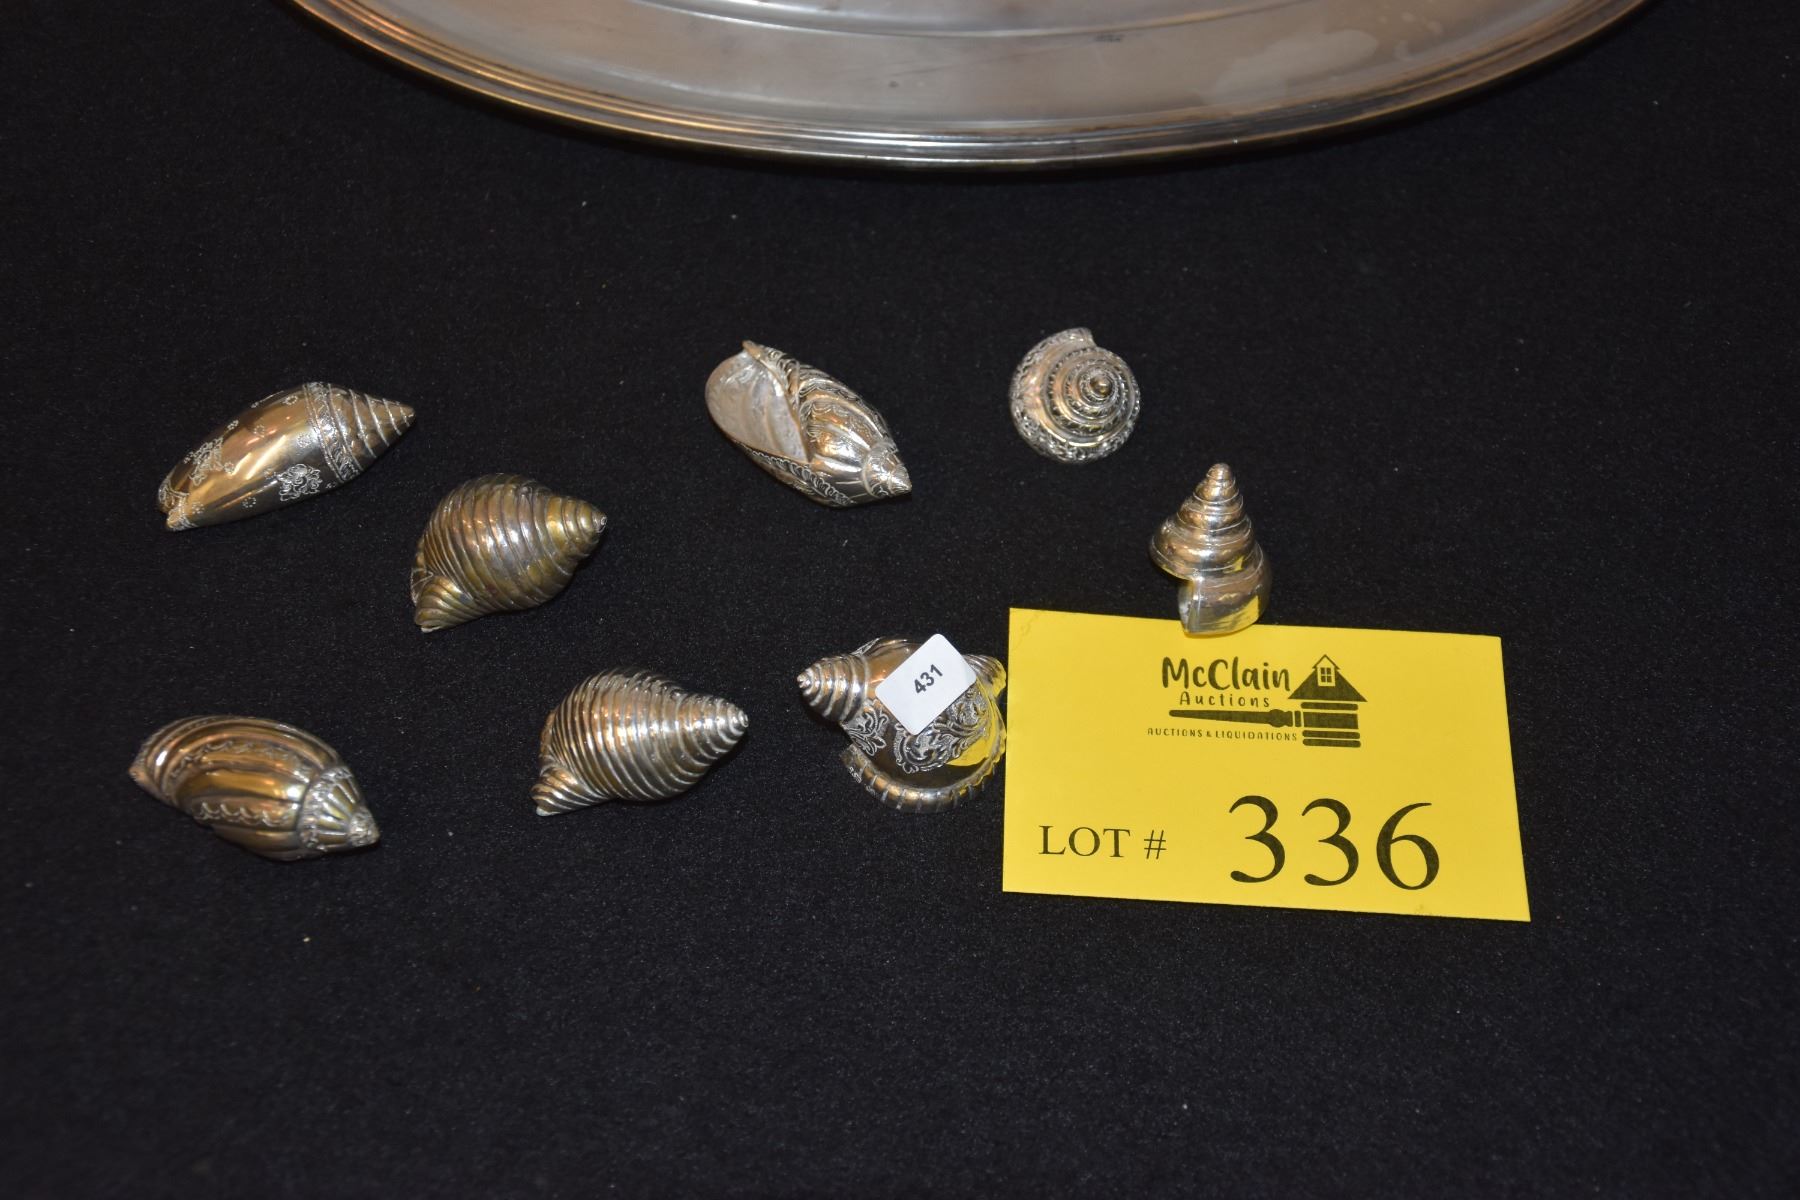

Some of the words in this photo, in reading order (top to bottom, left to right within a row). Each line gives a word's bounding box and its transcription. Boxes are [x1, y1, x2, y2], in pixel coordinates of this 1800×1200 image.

[914, 664, 943, 694] 431
[1161, 656, 1291, 692] McClain
[1179, 691, 1270, 708] Auctions
[1146, 727, 1203, 739] AUCTIONS
[1215, 730, 1297, 742] LIQUIDATIONS
[1041, 825, 1131, 858] LOT
[1145, 830, 1166, 859] #
[1229, 795, 1440, 891] 336
